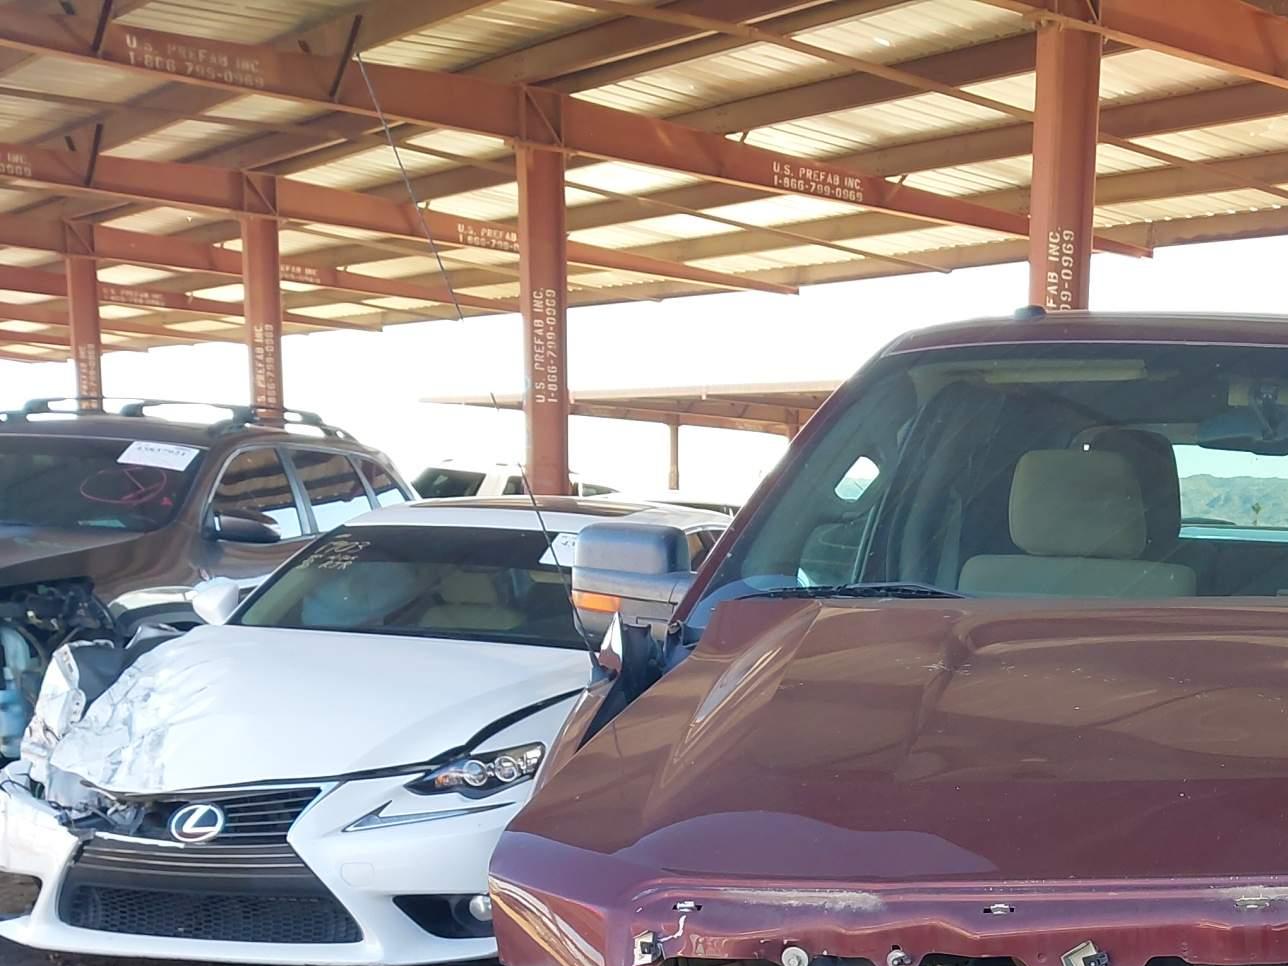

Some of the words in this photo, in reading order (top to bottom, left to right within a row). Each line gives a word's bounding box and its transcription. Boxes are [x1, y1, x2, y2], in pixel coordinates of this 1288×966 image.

[773, 161, 794, 177] U.S.
[799, 167, 840, 186] PREFAB
[773, 175, 864, 202] 1-866-799-0969
[533, 319, 545, 372] PREFAB
